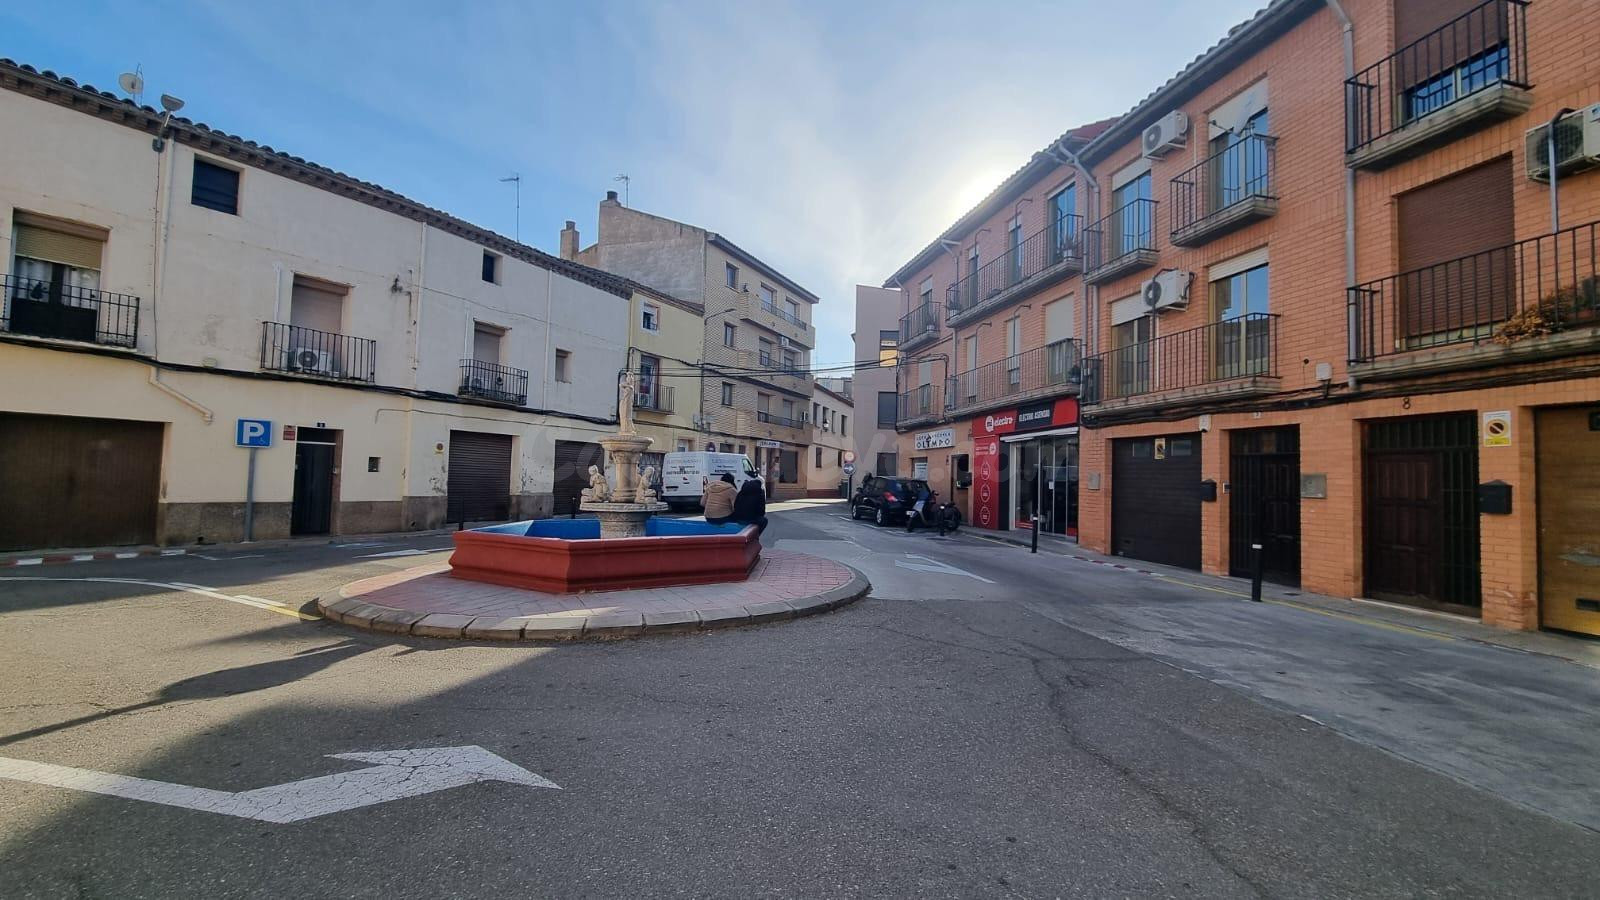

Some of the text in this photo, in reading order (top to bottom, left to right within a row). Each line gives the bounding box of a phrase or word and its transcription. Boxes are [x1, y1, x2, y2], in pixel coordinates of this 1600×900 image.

[1402, 397, 1411, 410] 8
[994, 416, 1014, 427] electro
[242, 421, 265, 444] P
